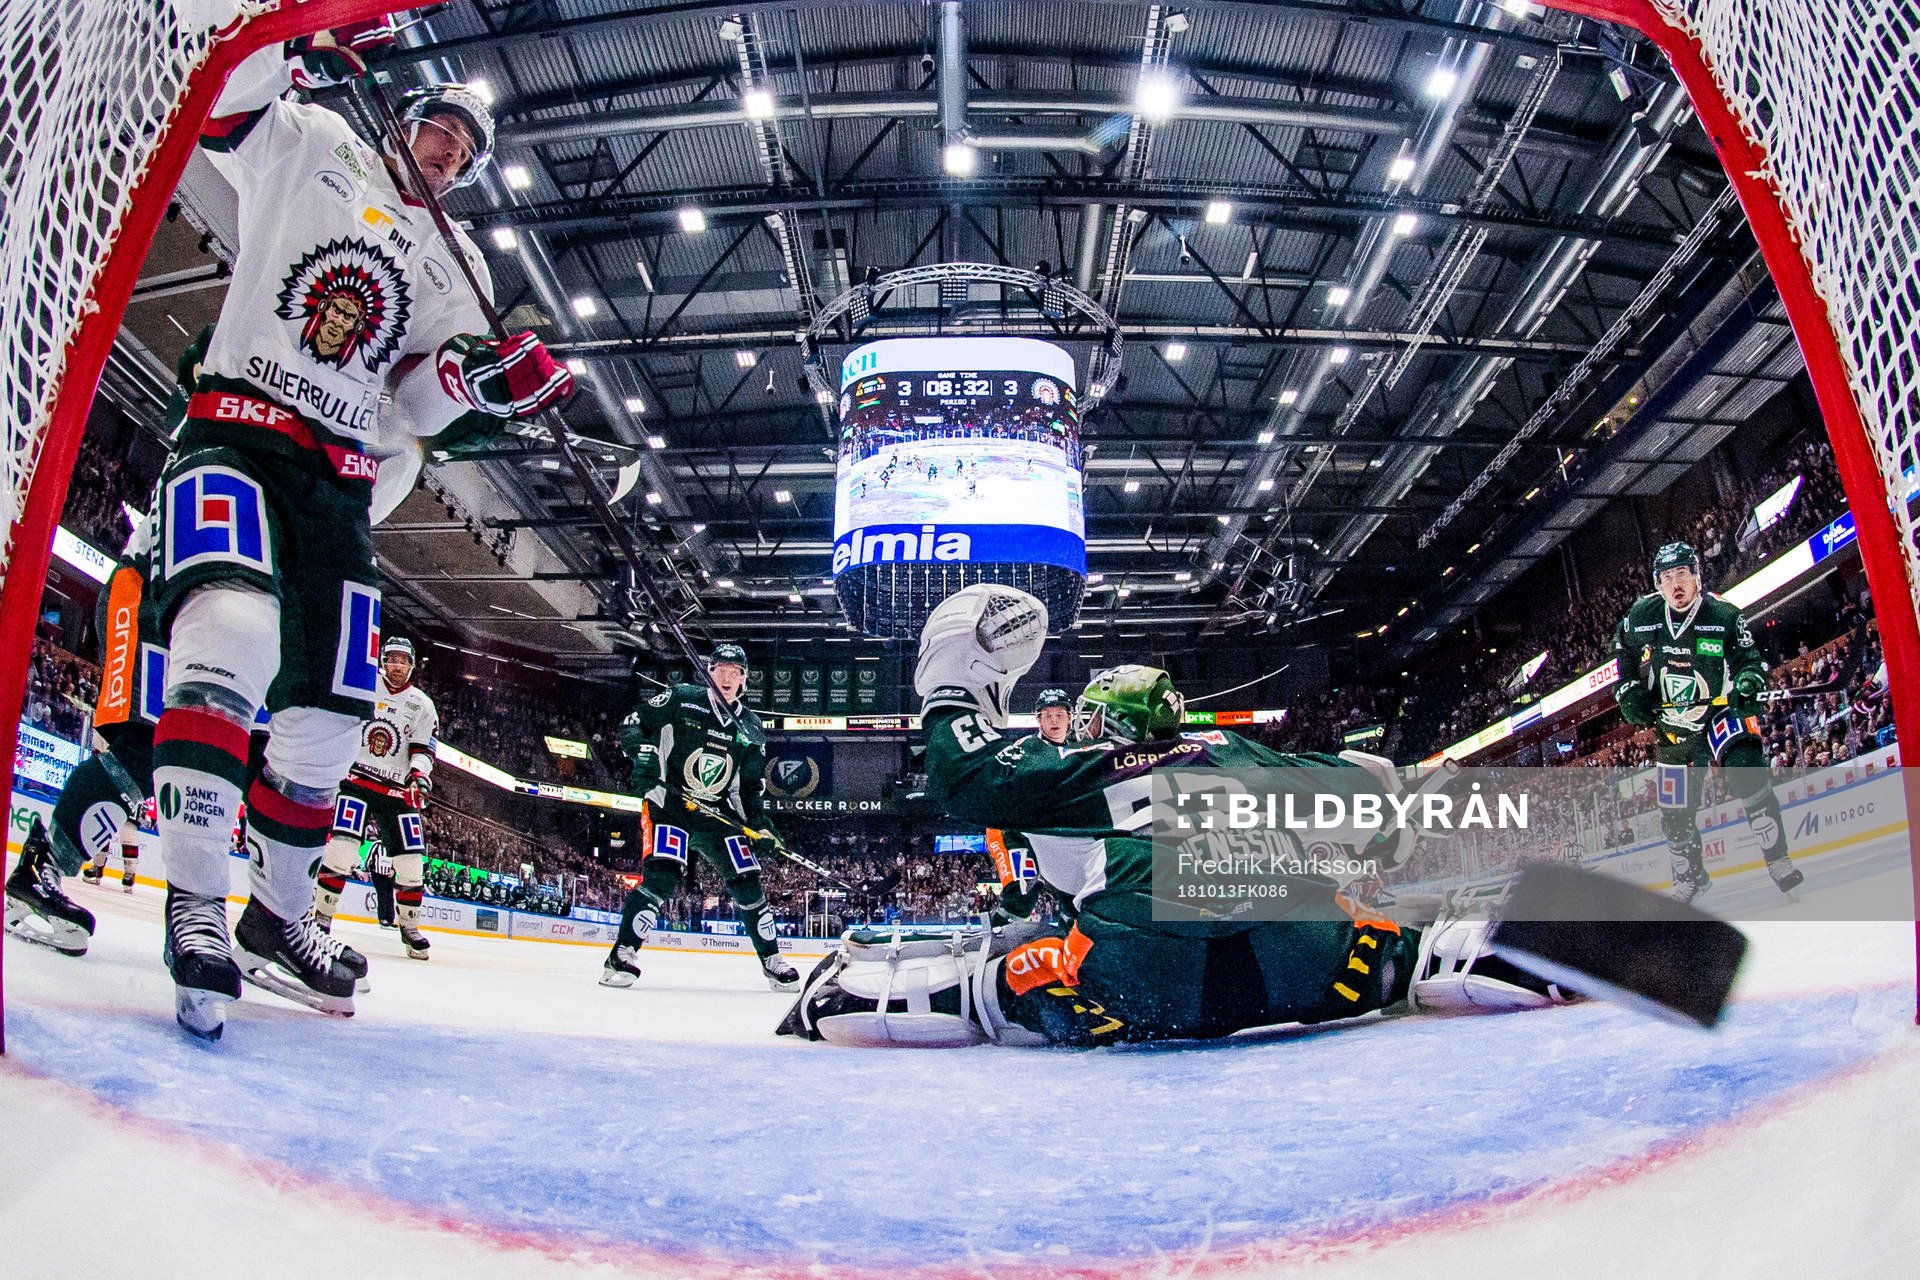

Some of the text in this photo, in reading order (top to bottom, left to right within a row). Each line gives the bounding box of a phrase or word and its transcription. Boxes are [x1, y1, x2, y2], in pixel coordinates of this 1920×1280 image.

[321, 175, 348, 199] BOHUS
[422, 261, 445, 290] BOHUS
[897, 381, 912, 396] 3
[926, 380, 990, 396] 08:32
[1003, 380, 1018, 396] 3
[216, 397, 292, 425] SKF
[75, 541, 105, 570] STENA
[109, 607, 131, 711] armat
[185, 785, 218, 803] SANKT
[184, 797, 225, 818] JÖRGEN
[776, 801, 833, 811] LOCKER
[838, 801, 882, 811] ROOM
[1824, 801, 1876, 827] MIDROC
[183, 812, 210, 829] PARK
[551, 923, 575, 937] CCM
[708, 938, 740, 948] Thermia
